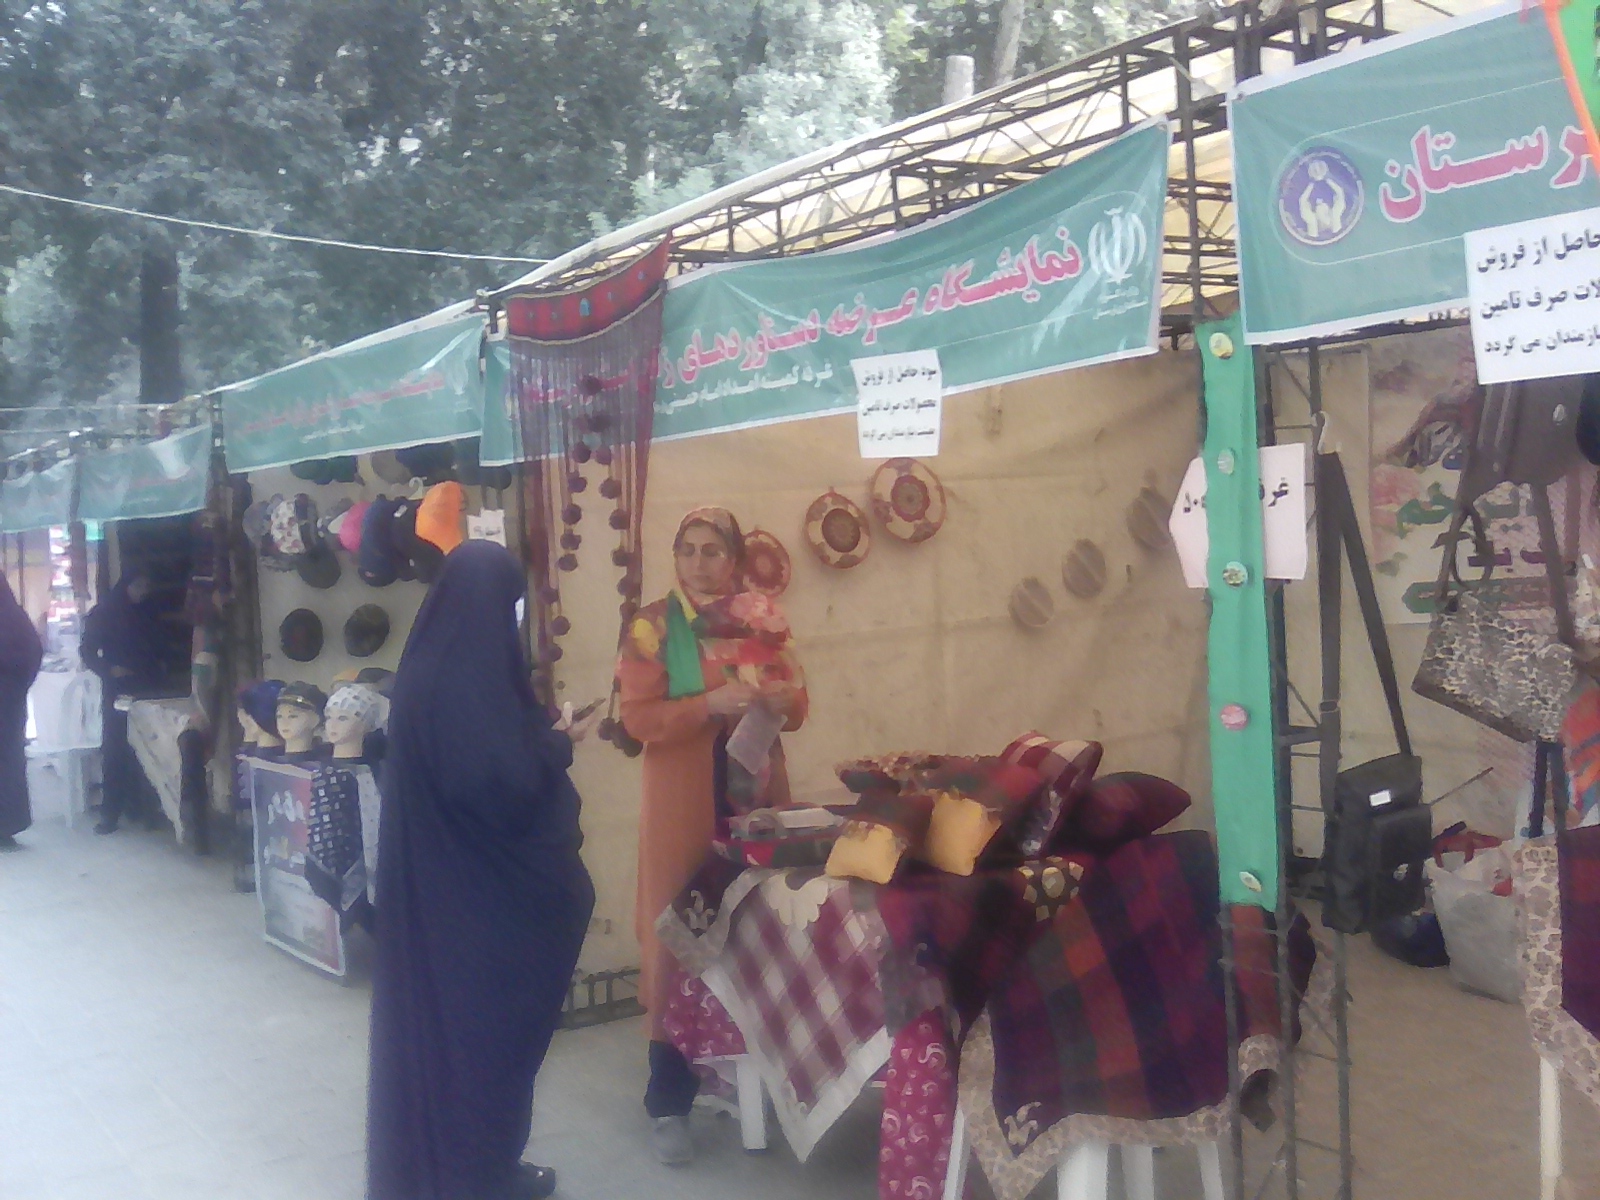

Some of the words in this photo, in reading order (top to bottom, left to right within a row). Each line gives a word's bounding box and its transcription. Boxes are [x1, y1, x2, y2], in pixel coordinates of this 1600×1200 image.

[1379, 124, 1590, 223] رستان
[1477, 238, 1525, 273] فروش
[1532, 236, 1548, 266] از
[923, 226, 1083, 315] نمایشگاه
[1480, 290, 1521, 319] تامین
[1525, 286, 1568, 313] صرف
[826, 287, 920, 346] عرضه
[676, 308, 821, 384] دستاوردهای
[1484, 335, 1516, 357] گردد
[1521, 338, 1541, 354] می
